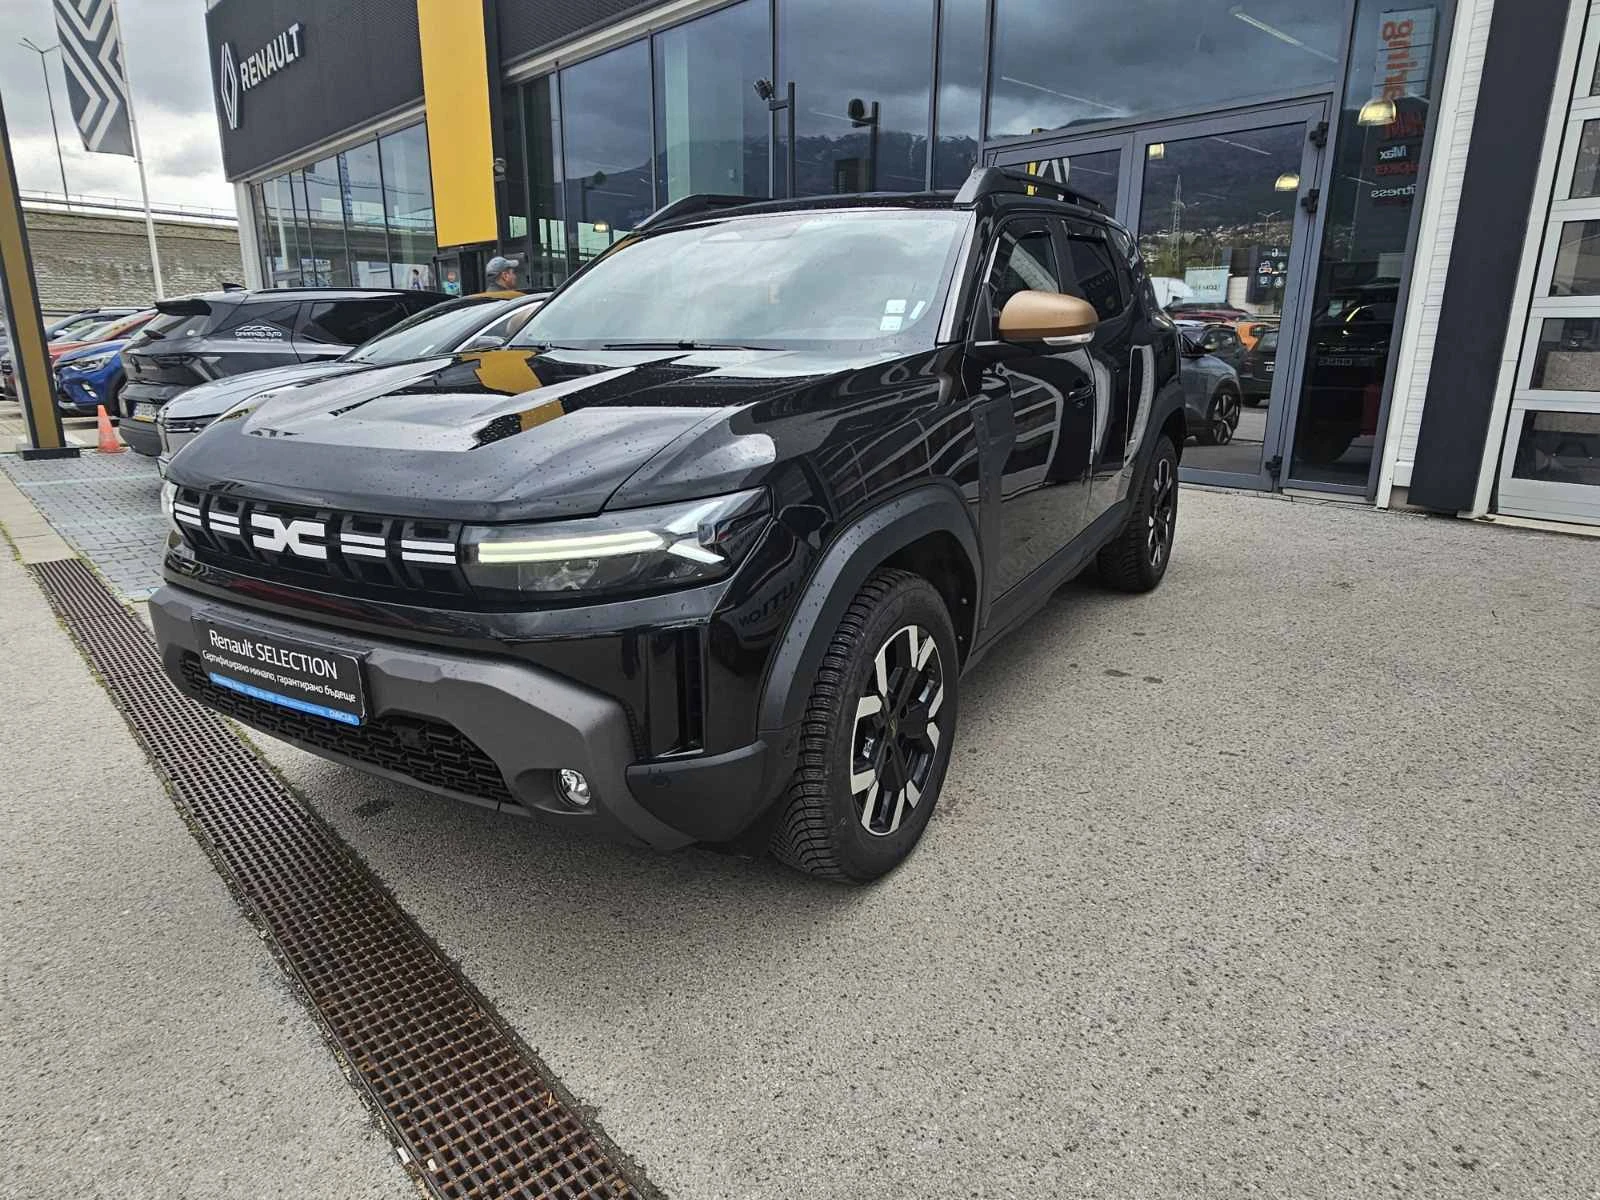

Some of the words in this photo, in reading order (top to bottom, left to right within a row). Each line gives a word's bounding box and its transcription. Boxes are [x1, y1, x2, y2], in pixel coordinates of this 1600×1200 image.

[240, 23, 299, 91] RENAULT
[209, 629, 255, 659] Renault
[256, 643, 338, 680] SELECTION
[277, 674, 324, 694] гарантирано
[324, 685, 356, 703] бъдеще
